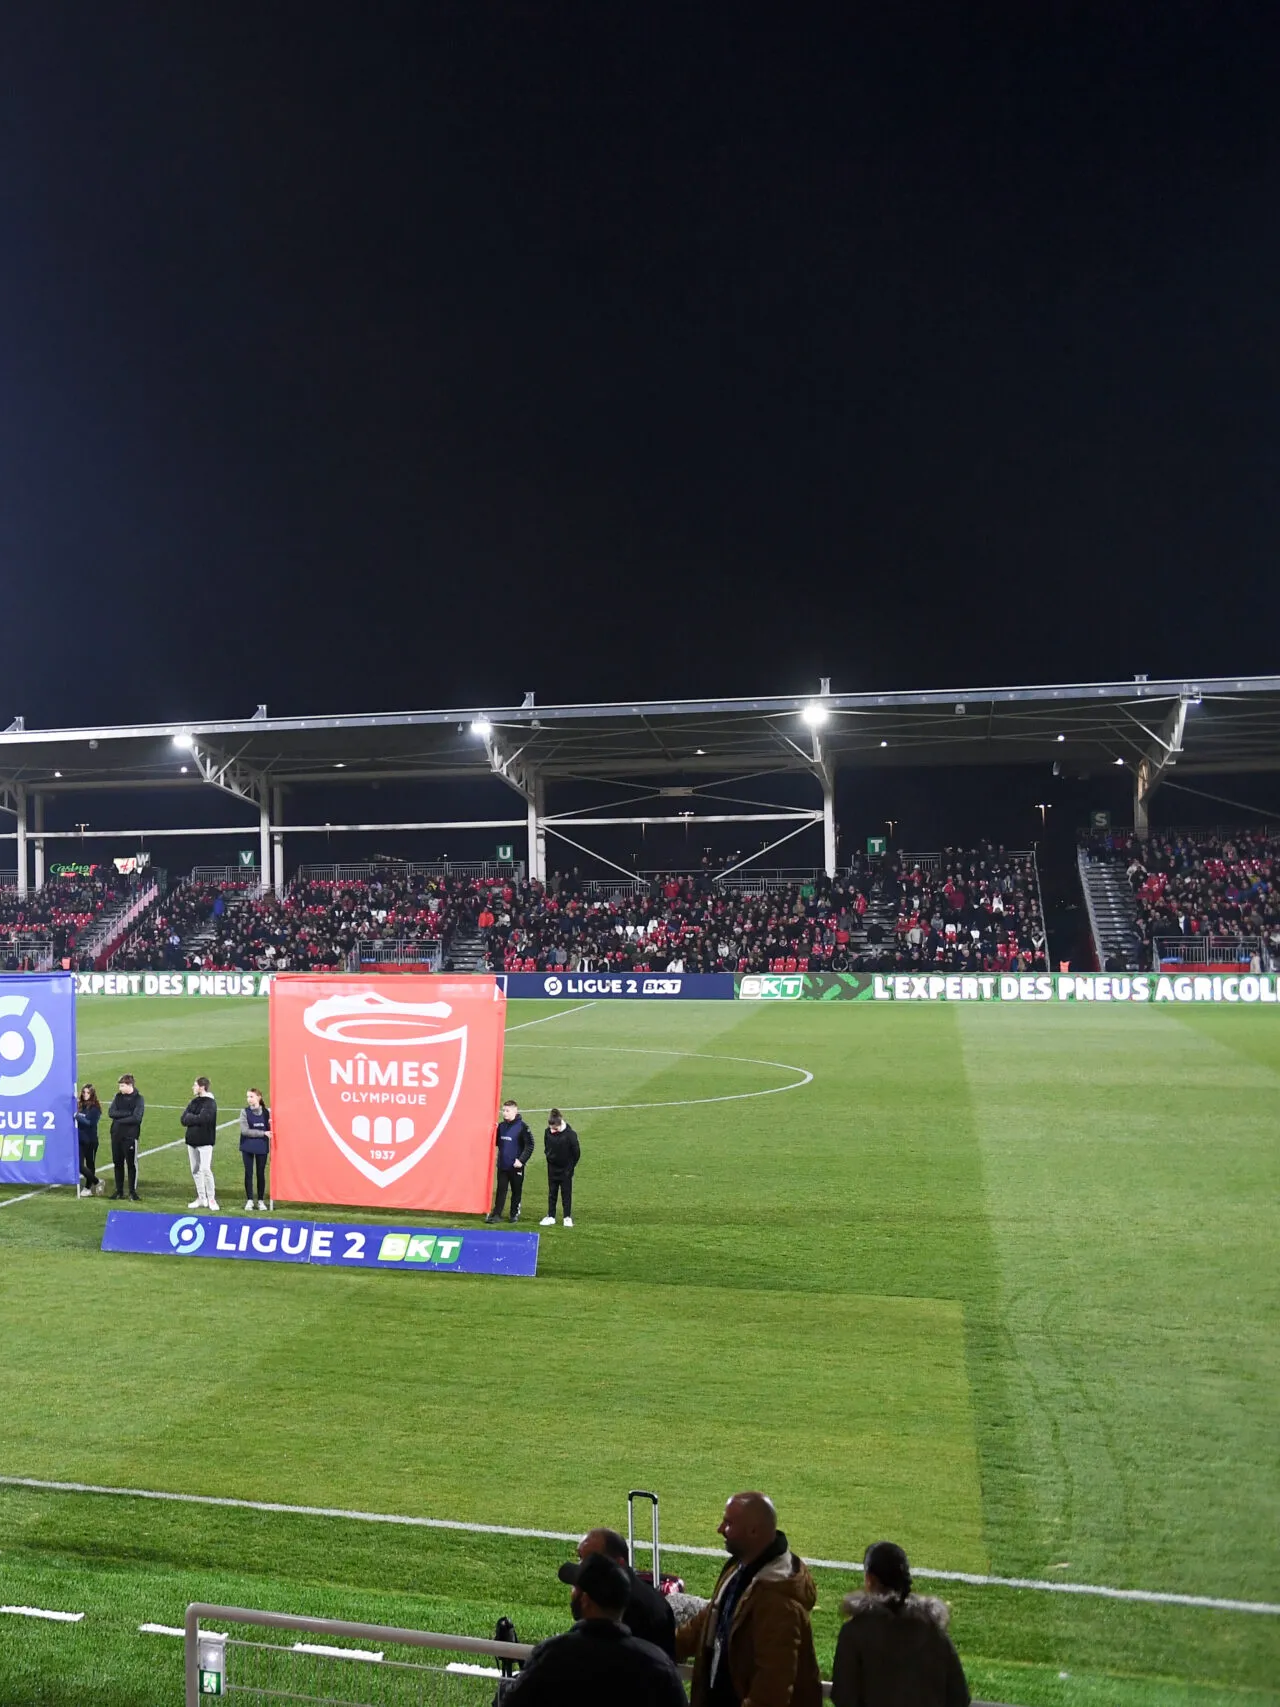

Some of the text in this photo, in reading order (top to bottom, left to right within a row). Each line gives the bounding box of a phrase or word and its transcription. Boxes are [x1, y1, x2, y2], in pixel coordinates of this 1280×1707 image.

[1095, 813, 1108, 826] S
[498, 846, 511, 859] U
[870, 839, 883, 853] T
[136, 854, 149, 867] W
[241, 852, 252, 865] V
[143, 974, 184, 995] DES
[187, 974, 255, 995] PNEUS
[567, 979, 682, 994] LIGUE 2 BKT
[740, 977, 802, 998] BKT
[874, 975, 1280, 1002] L'EXPERT DES PNEUS AGRICOL
[329, 1052, 439, 1088] NÎMES
[341, 1091, 428, 1105] OLYMPIQUE
[42, 1111, 56, 1130] 2
[370, 1149, 396, 1160] 1937
[216, 1224, 462, 1261] LIGUE 2 BKT
